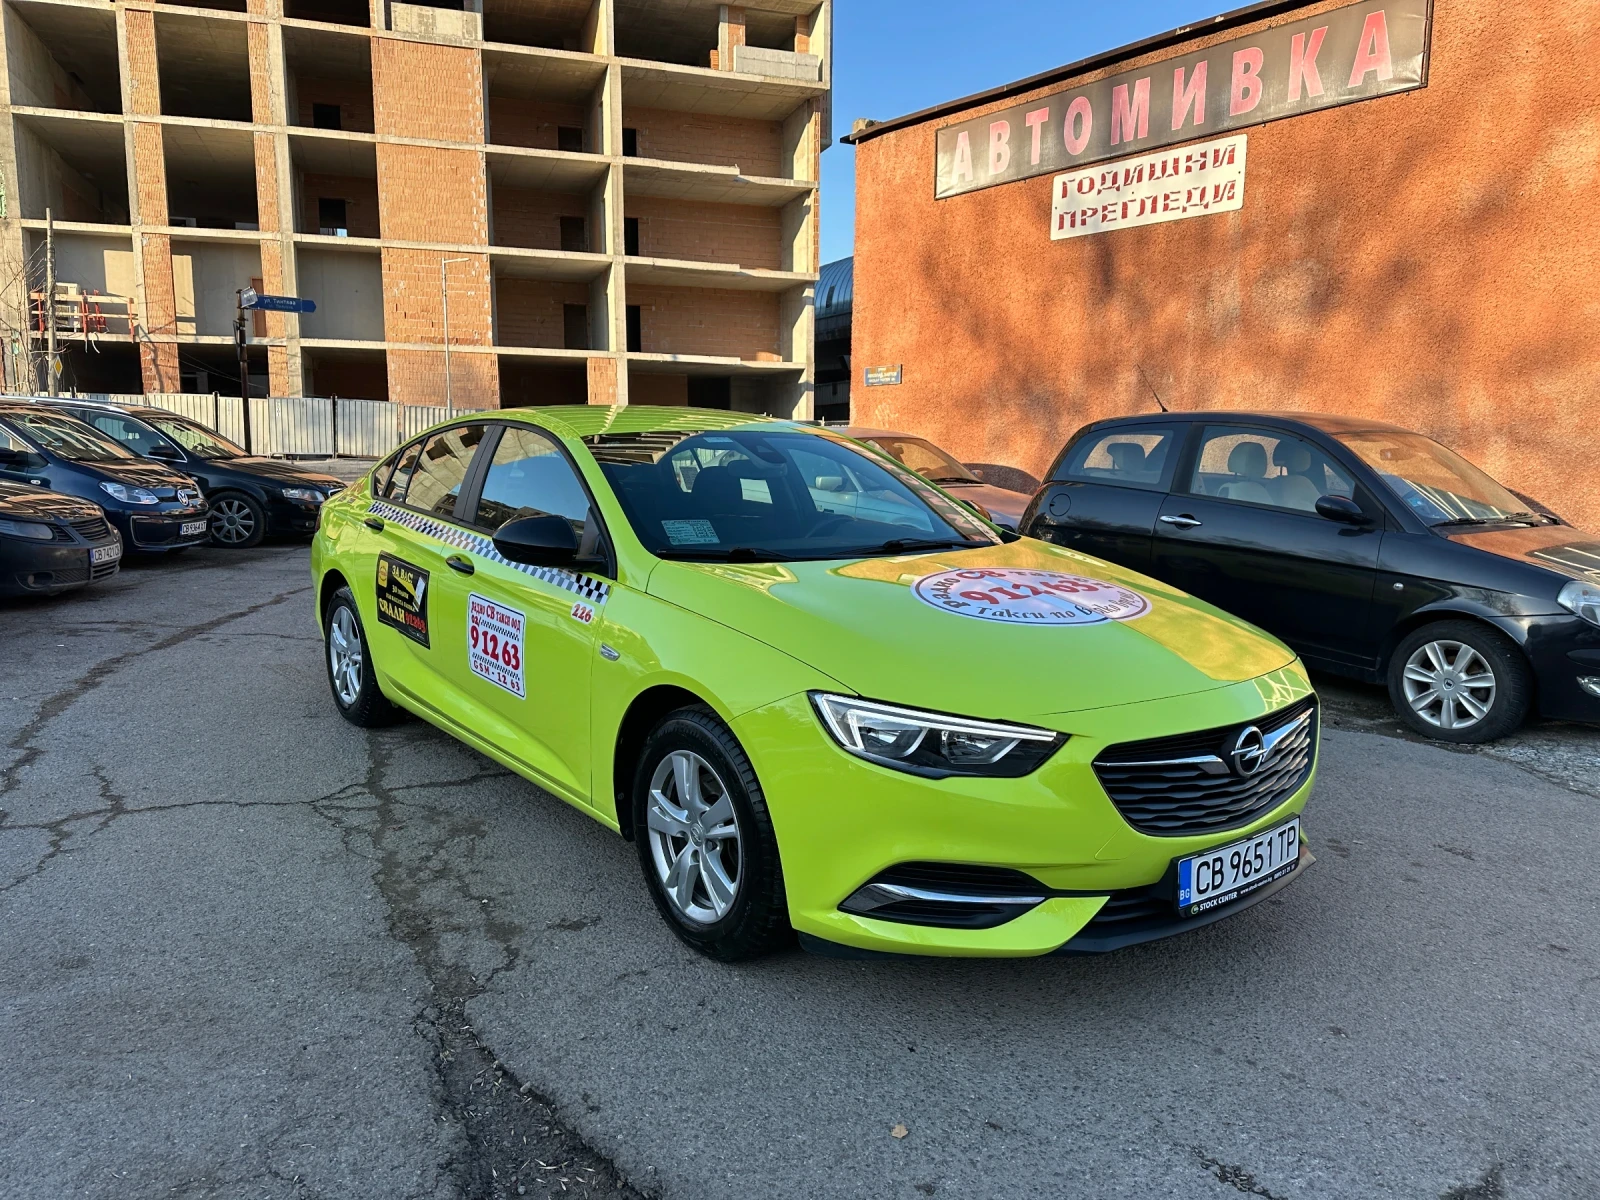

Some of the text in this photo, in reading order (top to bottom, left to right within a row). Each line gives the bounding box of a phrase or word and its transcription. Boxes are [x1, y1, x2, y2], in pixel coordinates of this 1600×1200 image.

[950, 9, 1394, 186] АВТОМИВКА
[1061, 143, 1237, 199] ГОДИШНИ
[1057, 179, 1238, 231] ПРЕГЛЕДИ
[959, 580, 1099, 605] 91263
[572, 603, 593, 622] 226
[473, 659, 490, 676] GSM
[1196, 856, 1224, 895] CB
[1229, 836, 1273, 884] 9651
[1278, 825, 1296, 862] TP
[1180, 888, 1190, 900] BG
[1200, 898, 1218, 911] STOCK
[1218, 891, 1238, 904] CENTER
